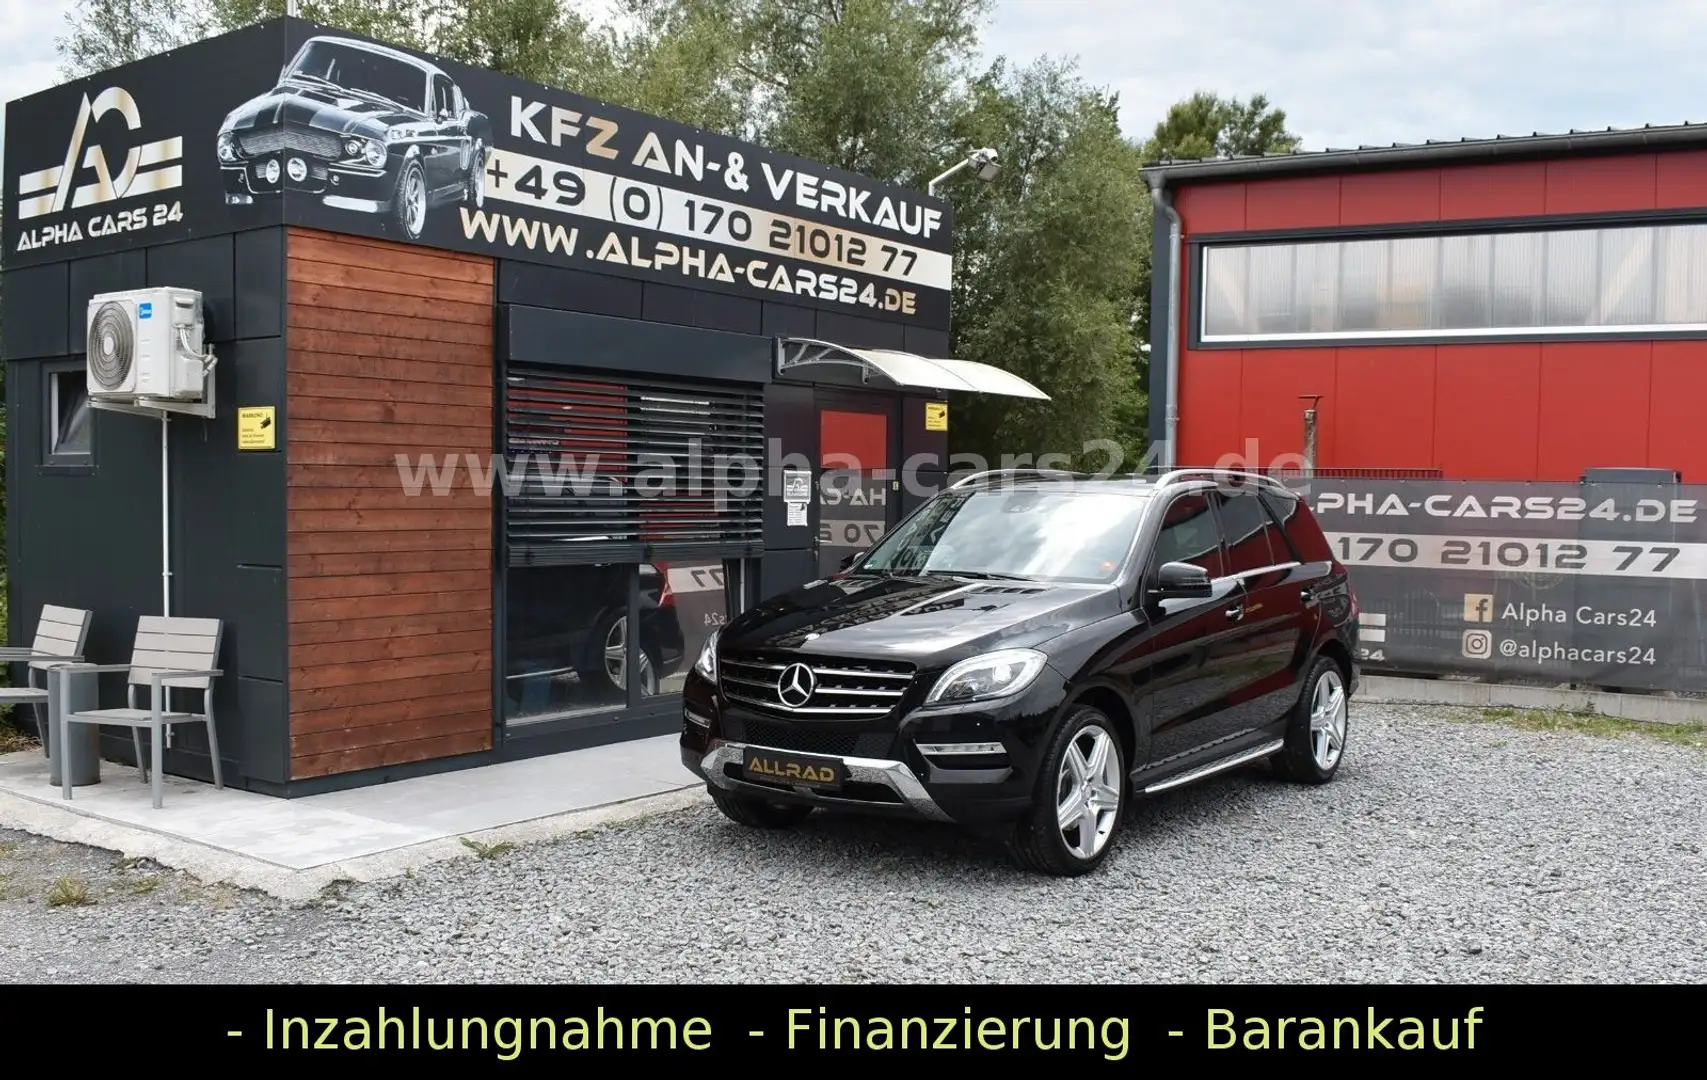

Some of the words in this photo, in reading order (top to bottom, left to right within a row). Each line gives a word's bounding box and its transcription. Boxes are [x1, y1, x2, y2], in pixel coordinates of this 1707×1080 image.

[510, 95, 619, 160] KFZ
[761, 162, 942, 238] VERKAUF
[17, 220, 83, 251] ALPHA
[88, 207, 147, 237] CARS
[153, 201, 183, 226] 24
[486, 158, 586, 207] +49
[610, 176, 663, 231] (0)
[684, 199, 751, 242] 170
[769, 219, 867, 267] 21012
[881, 244, 918, 277] 77
[1309, 492, 1699, 524] PHA-CARS24.DE
[1338, 536, 1419, 563] 170
[1440, 540, 1588, 570] 21012
[1612, 545, 1681, 573] 77
[1502, 602, 1567, 627] Alpha
[1576, 606, 1657, 627] Cars24
[1499, 638, 1657, 666] @alphacars24
[748, 756, 835, 783] ALLRAD
